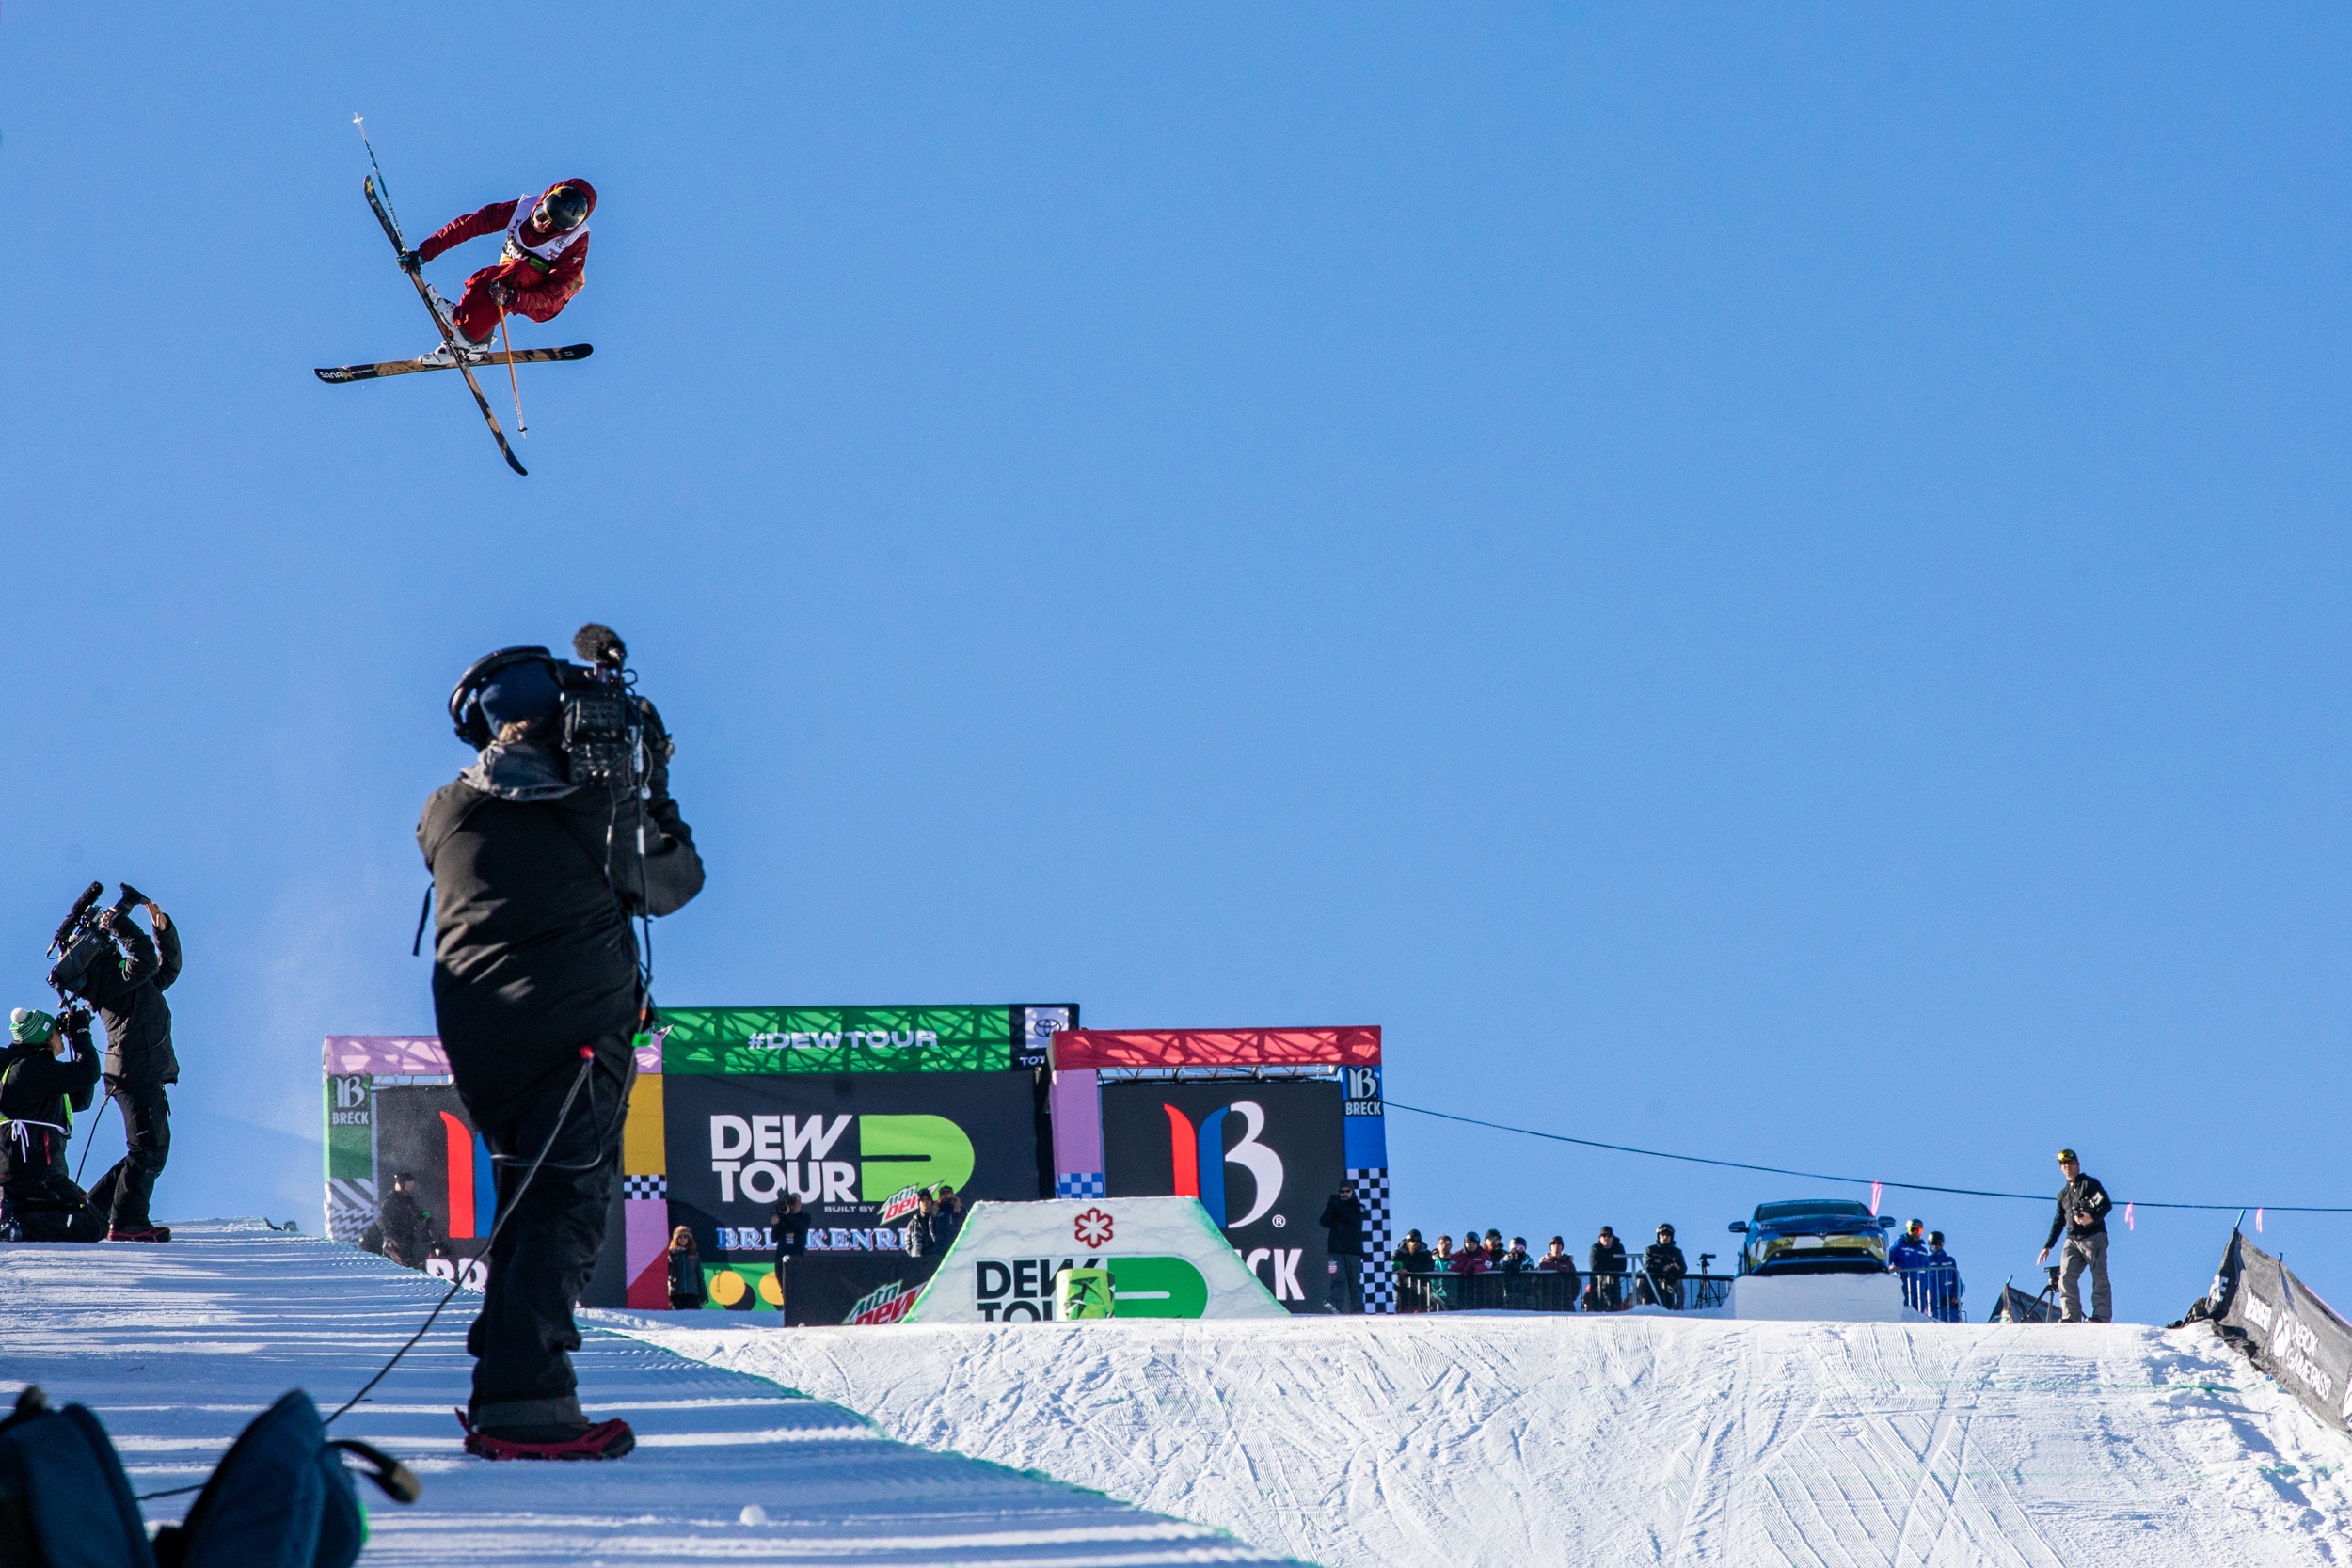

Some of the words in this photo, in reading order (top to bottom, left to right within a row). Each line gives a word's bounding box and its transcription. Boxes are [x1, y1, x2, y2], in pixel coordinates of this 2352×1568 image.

[748, 1030, 938, 1050] #DEWTOUR
[1019, 1055, 1046, 1067] TOY
[331, 1111, 370, 1125] BRECK
[1345, 1101, 1382, 1116] BRECK
[710, 1114, 853, 1160] DEW
[712, 1161, 859, 1204] TOUR
[824, 1205, 857, 1213] BUILT
[859, 1205, 876, 1213] BY
[2290, 1321, 2320, 1358] XBOX
[2285, 1347, 2312, 1384] GAME
[2310, 1366, 2332, 1401] PASS
